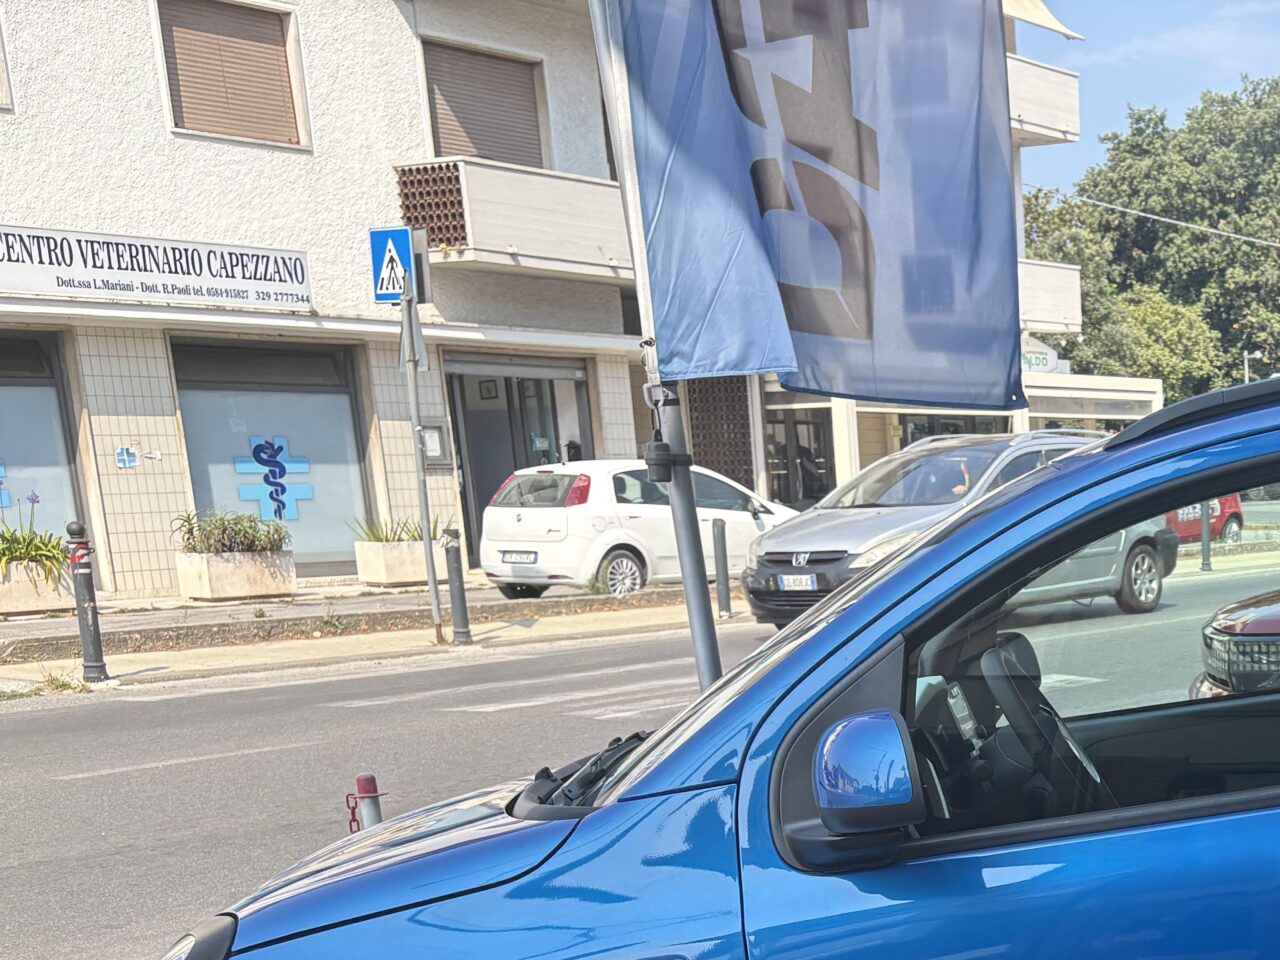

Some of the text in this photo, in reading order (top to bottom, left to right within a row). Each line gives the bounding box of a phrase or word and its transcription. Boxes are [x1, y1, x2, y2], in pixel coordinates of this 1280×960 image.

[76, 239, 203, 277] VETERINARIO
[207, 249, 305, 285] CAPEZZANO
[56, 276, 92, 290] Dott.ssa
[93, 278, 134, 293] L.Mariani
[140, 282, 161, 295] Dott.
[162, 283, 192, 296] R.Paoli
[192, 285, 206, 297] tel.
[255, 291, 271, 302] 329
[274, 291, 311, 304] 2777344
